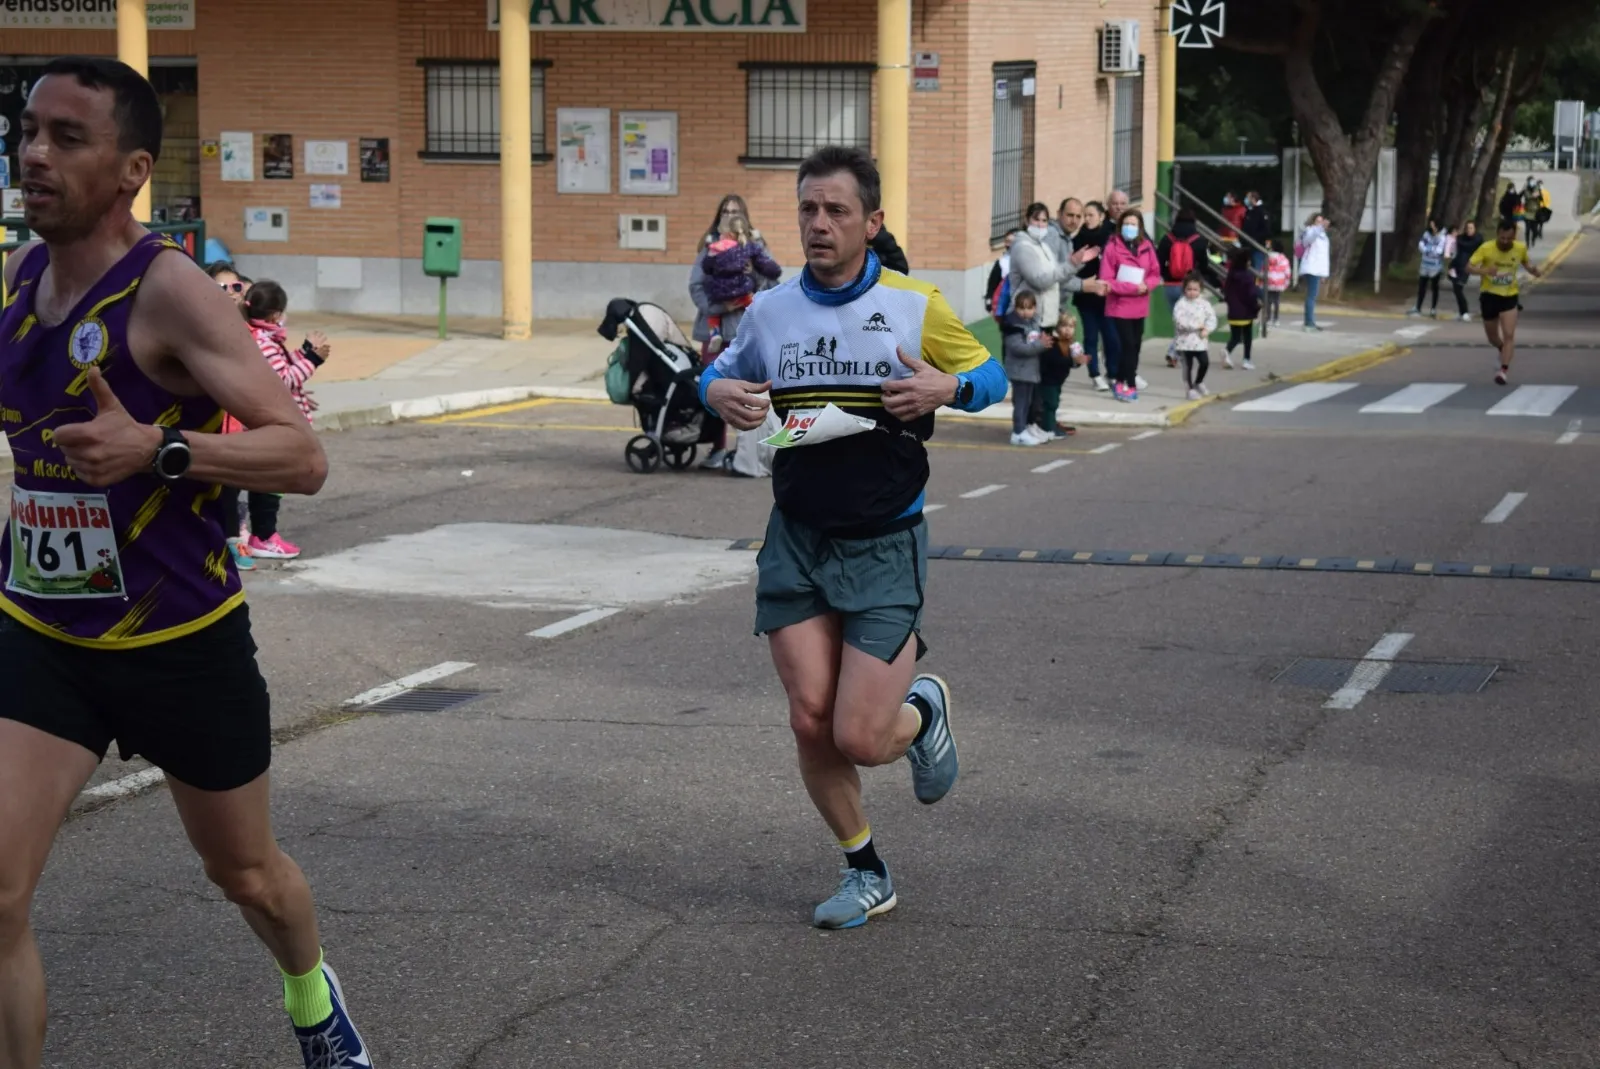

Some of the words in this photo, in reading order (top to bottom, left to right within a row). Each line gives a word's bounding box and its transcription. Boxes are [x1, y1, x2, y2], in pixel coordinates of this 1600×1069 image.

[148, 14, 183, 25] egalos
[10, 490, 110, 529] bedunia
[20, 526, 87, 572] 761
